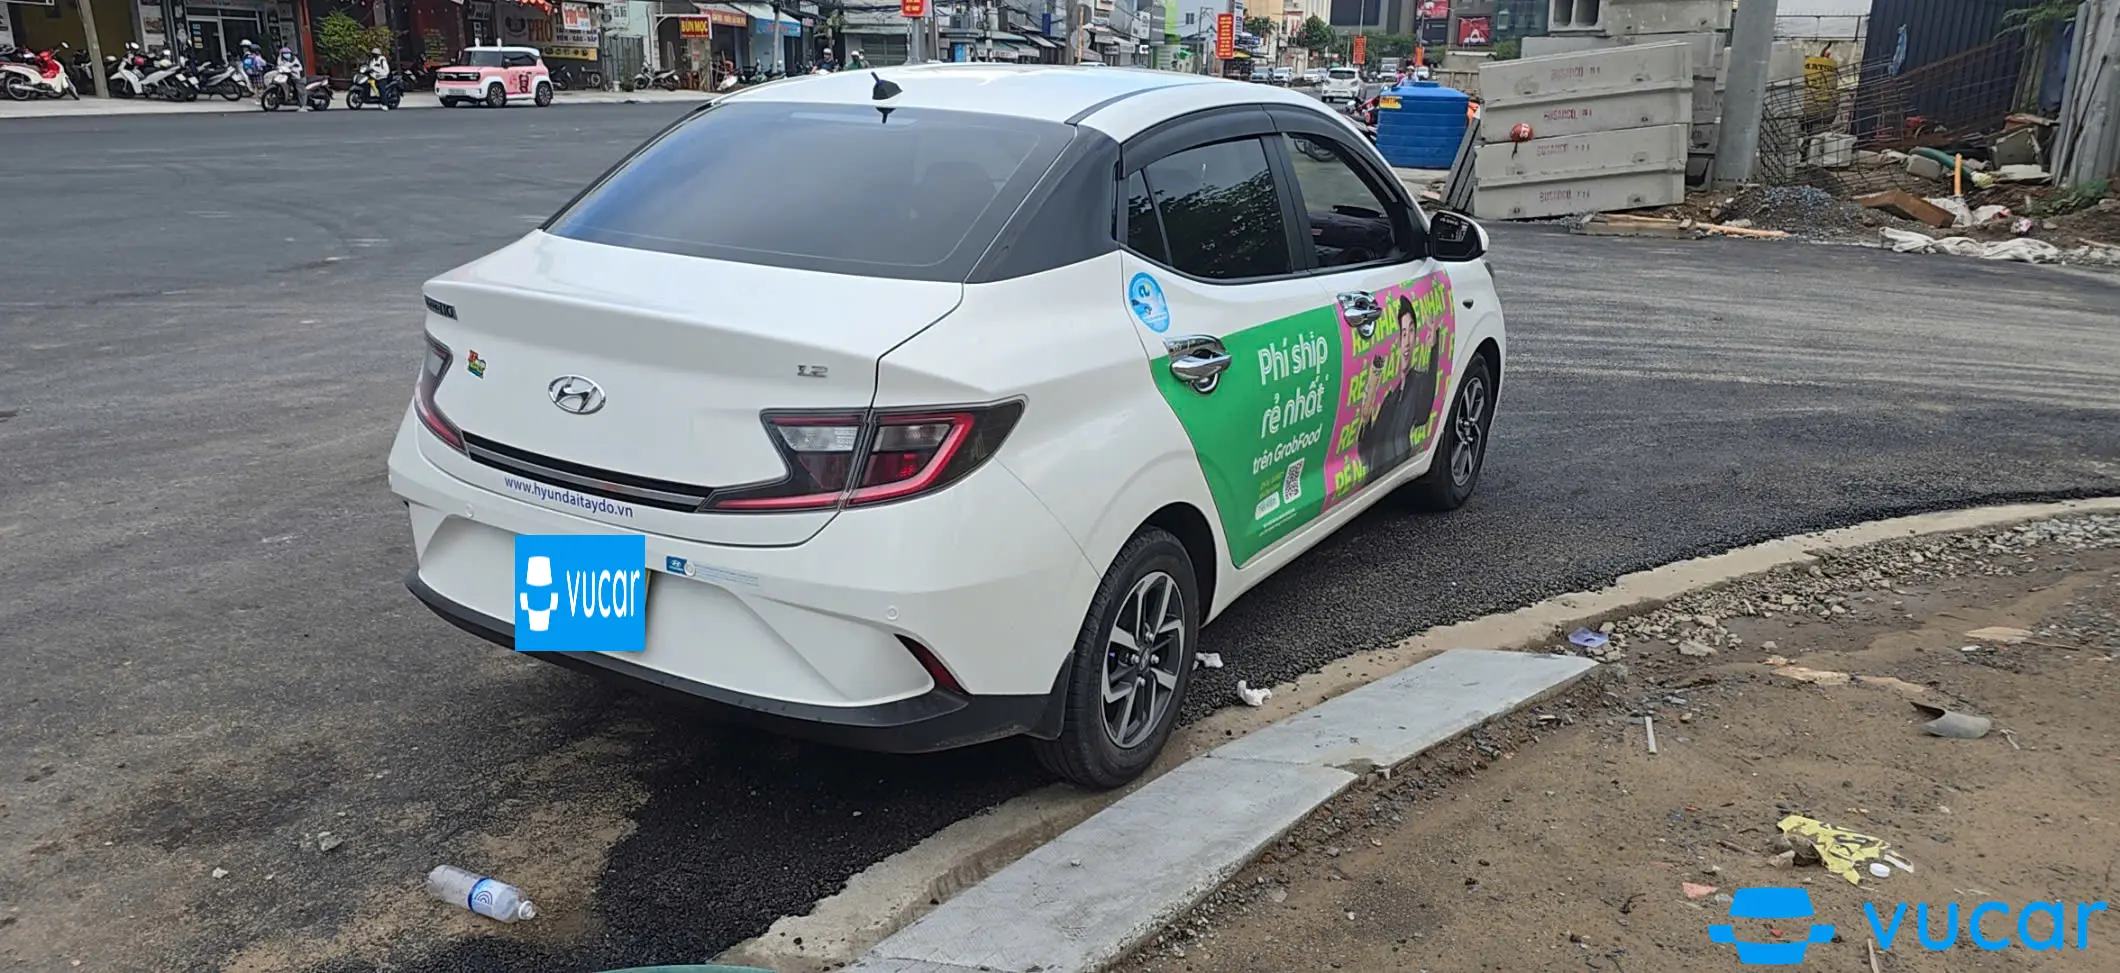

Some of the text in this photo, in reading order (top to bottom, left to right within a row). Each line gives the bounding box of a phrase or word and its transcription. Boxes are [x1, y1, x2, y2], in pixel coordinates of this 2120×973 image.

[1258, 331, 1328, 385] Phí ship
[1261, 374, 1325, 439] rẻ nhất
[1253, 423, 1323, 475] trên GrabFood
[504, 477, 633, 518] www.hyundaitaydo.vn
